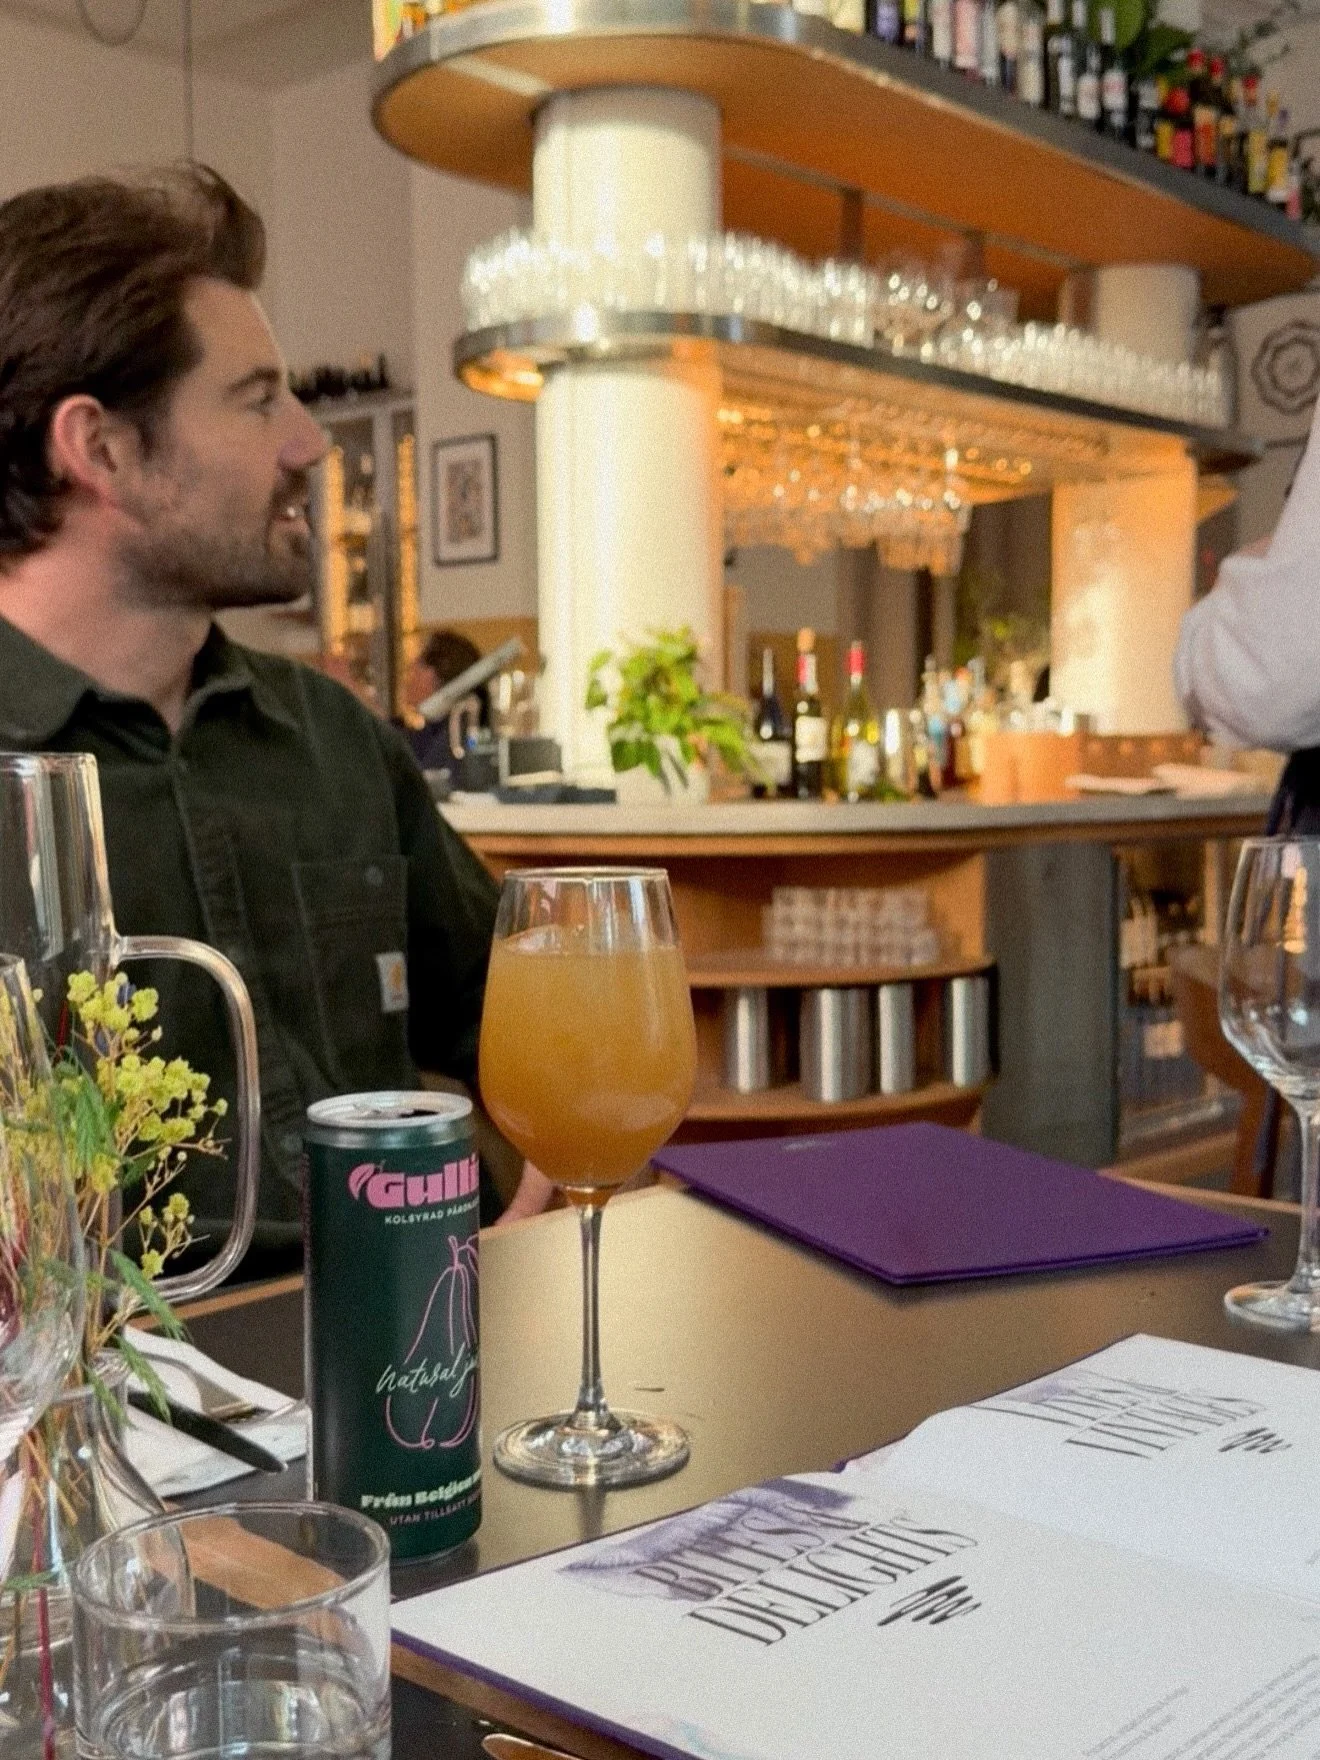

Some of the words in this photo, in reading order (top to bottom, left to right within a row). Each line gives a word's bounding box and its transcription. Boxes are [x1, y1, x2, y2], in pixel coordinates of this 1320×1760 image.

[384, 1210, 444, 1225] KOLSYRAD
[1060, 1389, 1268, 1460] VINTAGES
[632, 1516, 825, 1601] BITES
[684, 1514, 978, 1646] DELIGHTS
